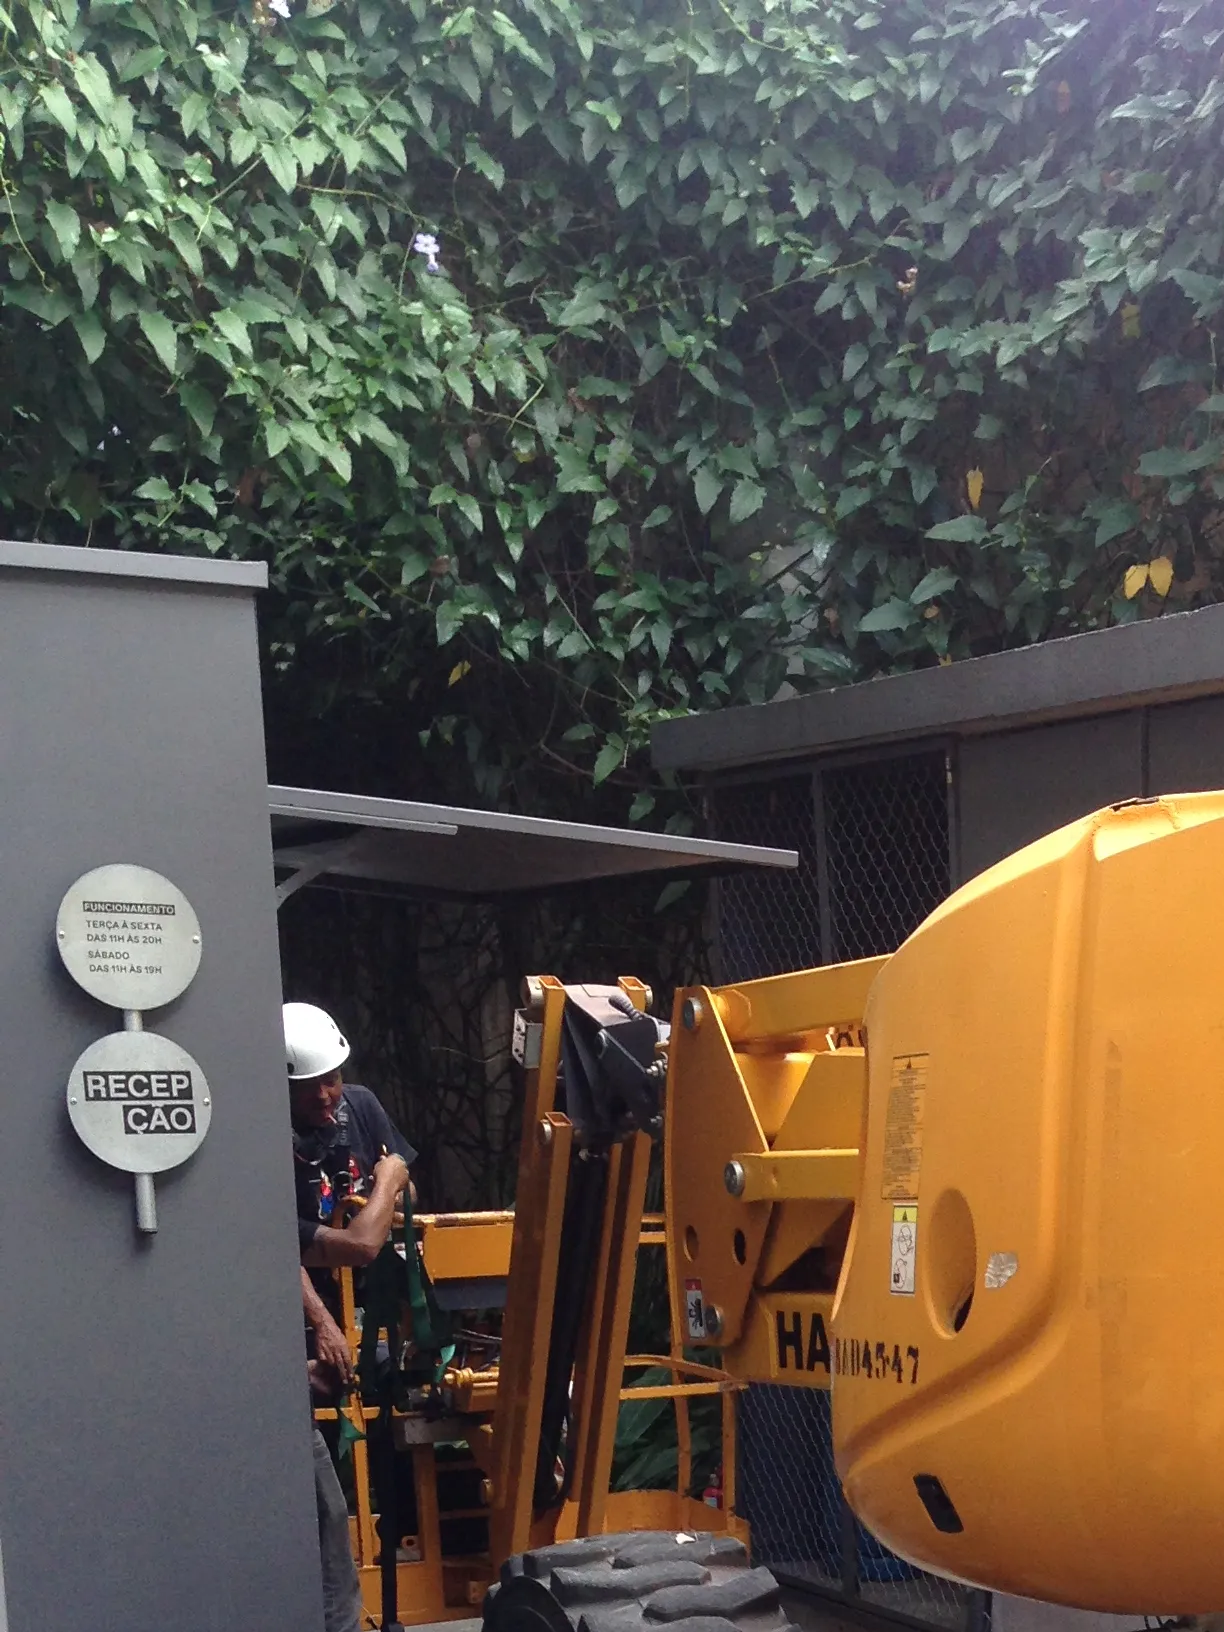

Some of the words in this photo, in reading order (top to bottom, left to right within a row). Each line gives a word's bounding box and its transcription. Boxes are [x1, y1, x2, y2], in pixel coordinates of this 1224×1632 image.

[84, 902, 174, 914] FUNCIONAMENTO
[86, 920, 119, 930] TERÇA
[130, 922, 163, 931] SEXTA
[86, 933, 107, 943] DAS
[109, 934, 125, 943] 11H
[142, 935, 162, 944] 20H
[88, 949, 130, 960] SÁBADO
[89, 964, 109, 973] DAS
[86, 1073, 190, 1099] RECEP
[126, 1101, 193, 1134] ÇÃO
